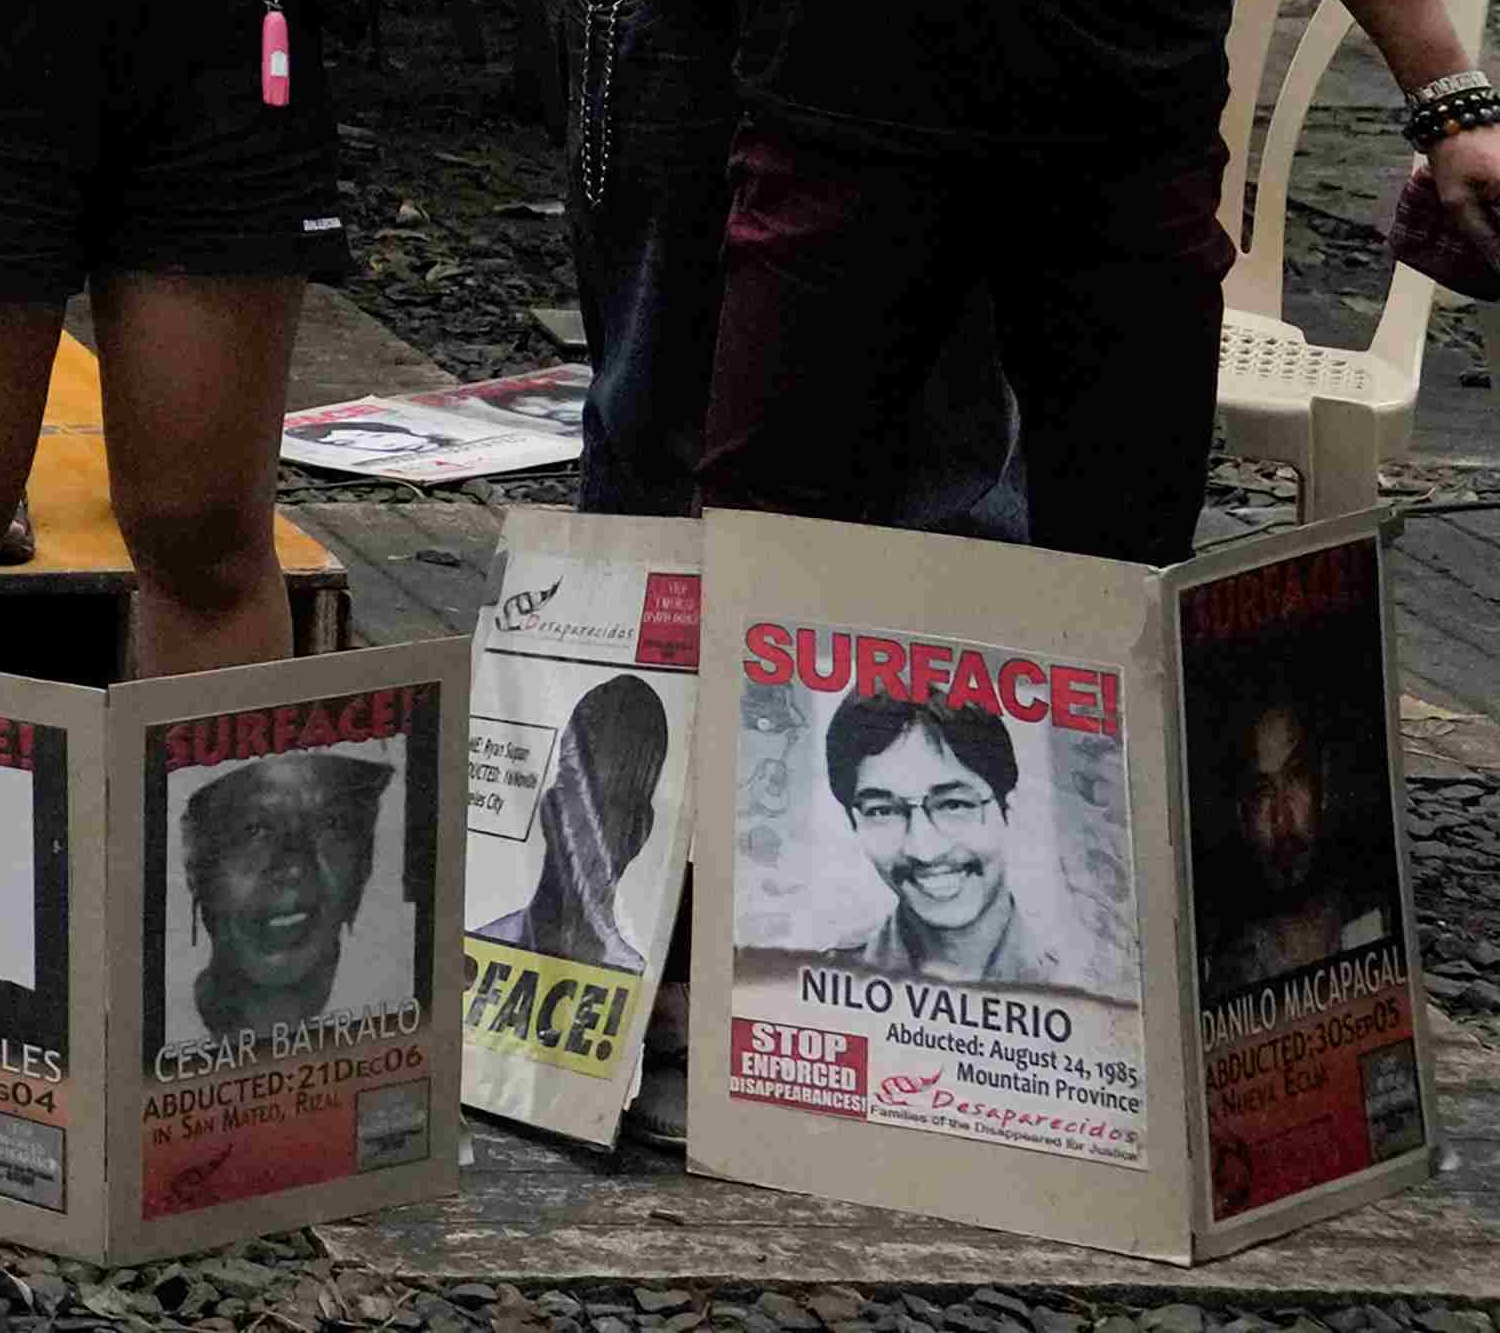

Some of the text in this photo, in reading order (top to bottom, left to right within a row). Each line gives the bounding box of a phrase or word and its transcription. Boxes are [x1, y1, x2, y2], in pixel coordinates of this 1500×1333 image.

[742, 622, 1121, 736] SURFACE!
[163, 689, 418, 769] SURFACE!
[801, 968, 1072, 1044] NILO VALERIO
[1201, 944, 1408, 1053] DANILO MACAPAGAL
[154, 997, 422, 1084] CESAR BATRALO
[750, 1021, 848, 1064] STOP
[885, 1022, 1138, 1090] Abducted: August 24, 1985
[730, 1074, 868, 1114] DISAPPEARANCES!
[741, 1052, 857, 1092] ENFORCED
[956, 1061, 1140, 1115] Mountain Province
[870, 1104, 928, 1126] Families
[931, 1114, 945, 1128] of
[947, 1117, 970, 1131] the
[973, 1120, 1063, 1149] Disappeared
[1065, 1134, 1086, 1151] for
[931, 1089, 1140, 1145] Desaparecidos
